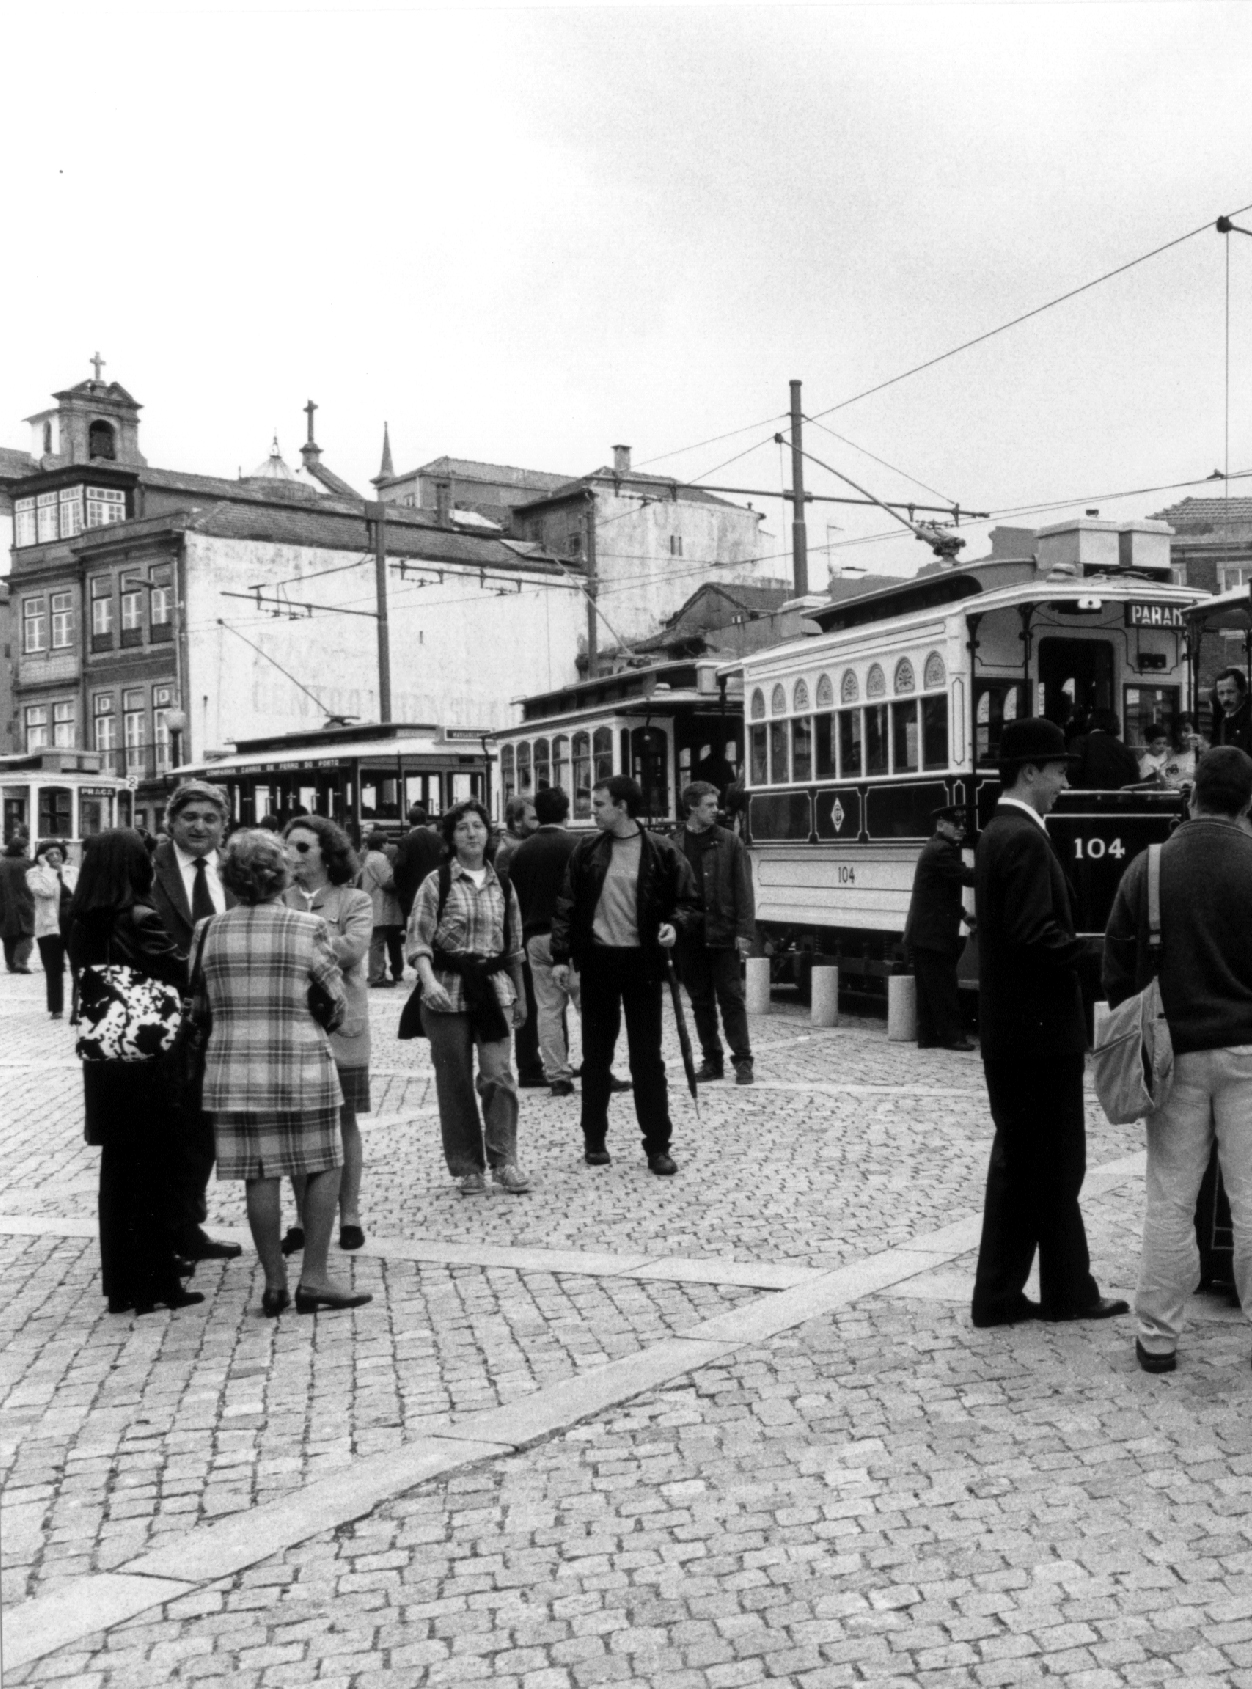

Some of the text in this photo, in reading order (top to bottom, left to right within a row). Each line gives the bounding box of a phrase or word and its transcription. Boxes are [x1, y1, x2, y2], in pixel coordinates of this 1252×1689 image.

[1131, 605, 1186, 626] PARAN
[1074, 837, 1126, 859] 104
[838, 866, 856, 884] 104
